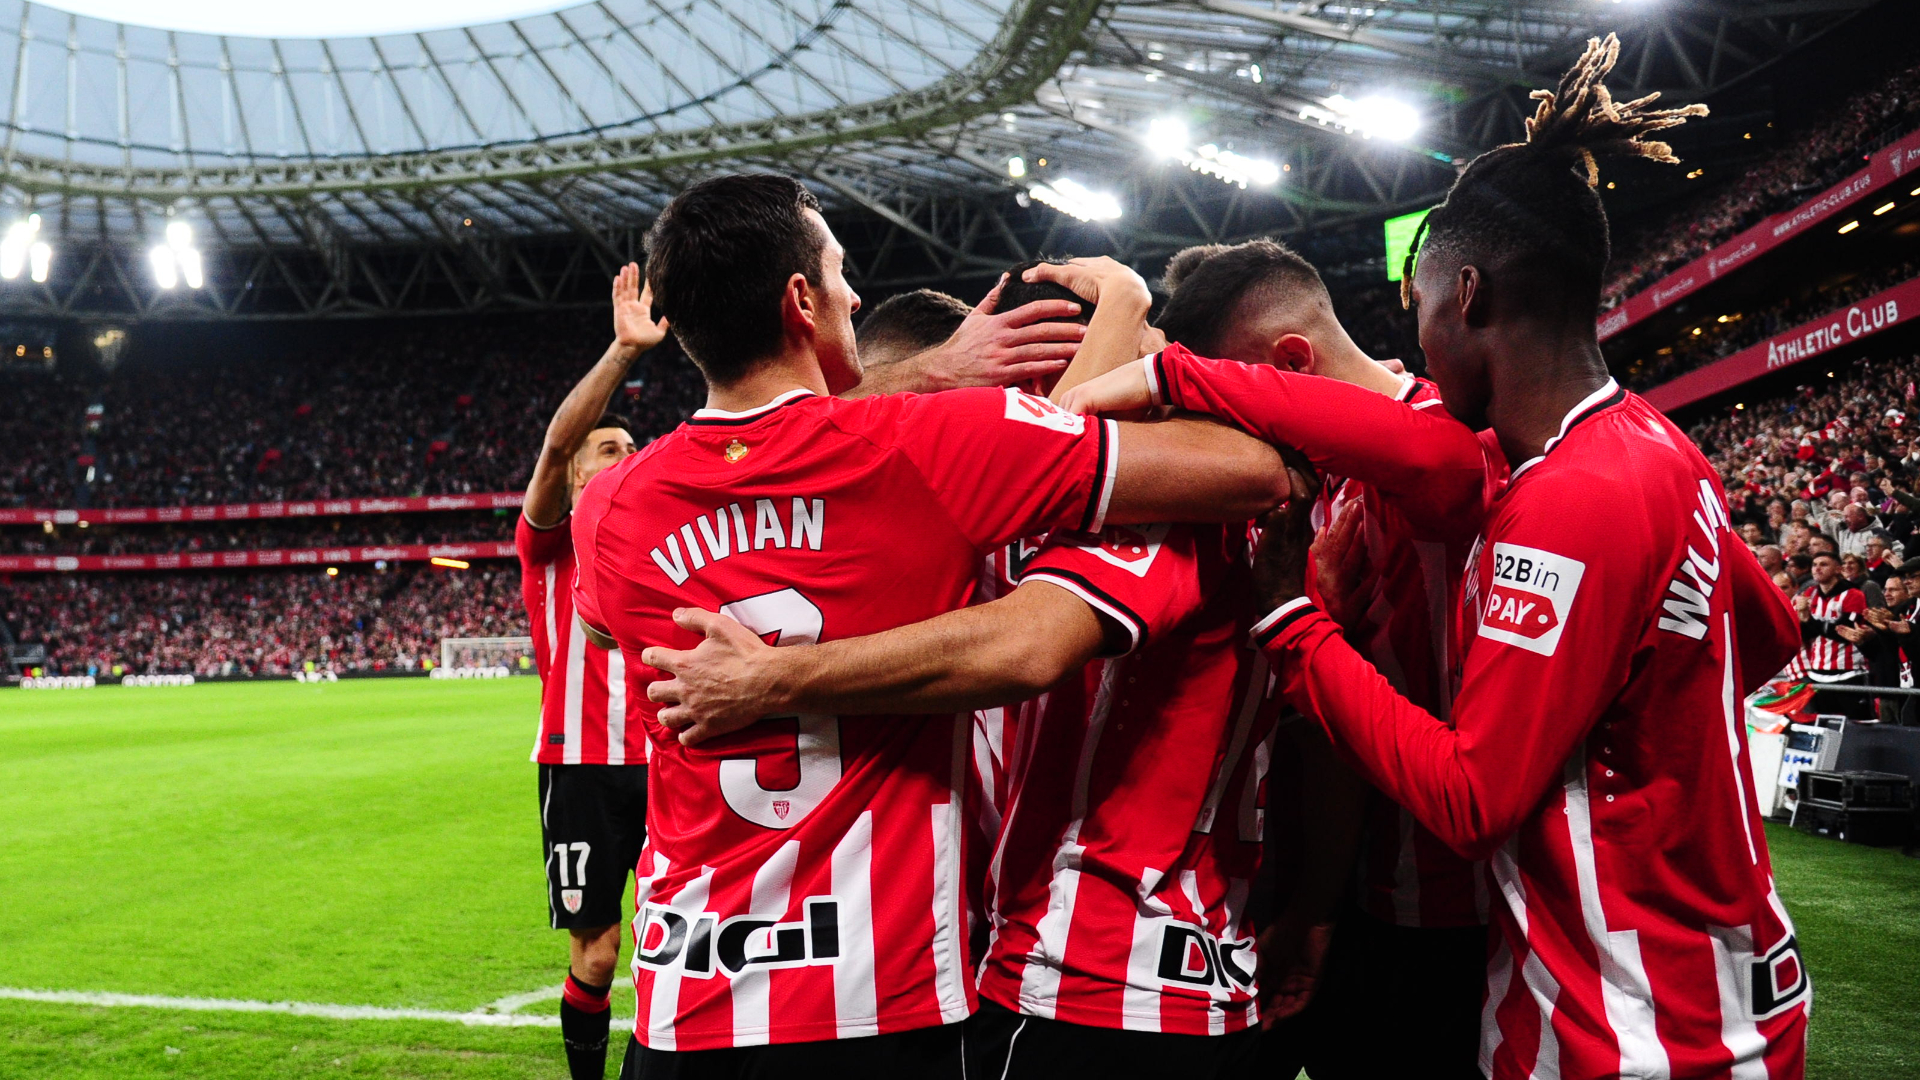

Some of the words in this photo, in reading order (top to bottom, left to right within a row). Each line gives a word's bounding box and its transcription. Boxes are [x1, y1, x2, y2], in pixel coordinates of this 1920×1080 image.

[1767, 323, 1842, 369] ATHLETIC
[1847, 300, 1898, 337] CLUB
[650, 497, 825, 587] VIVIAN
[1487, 593, 1537, 625] PAY
[553, 841, 591, 887] 17
